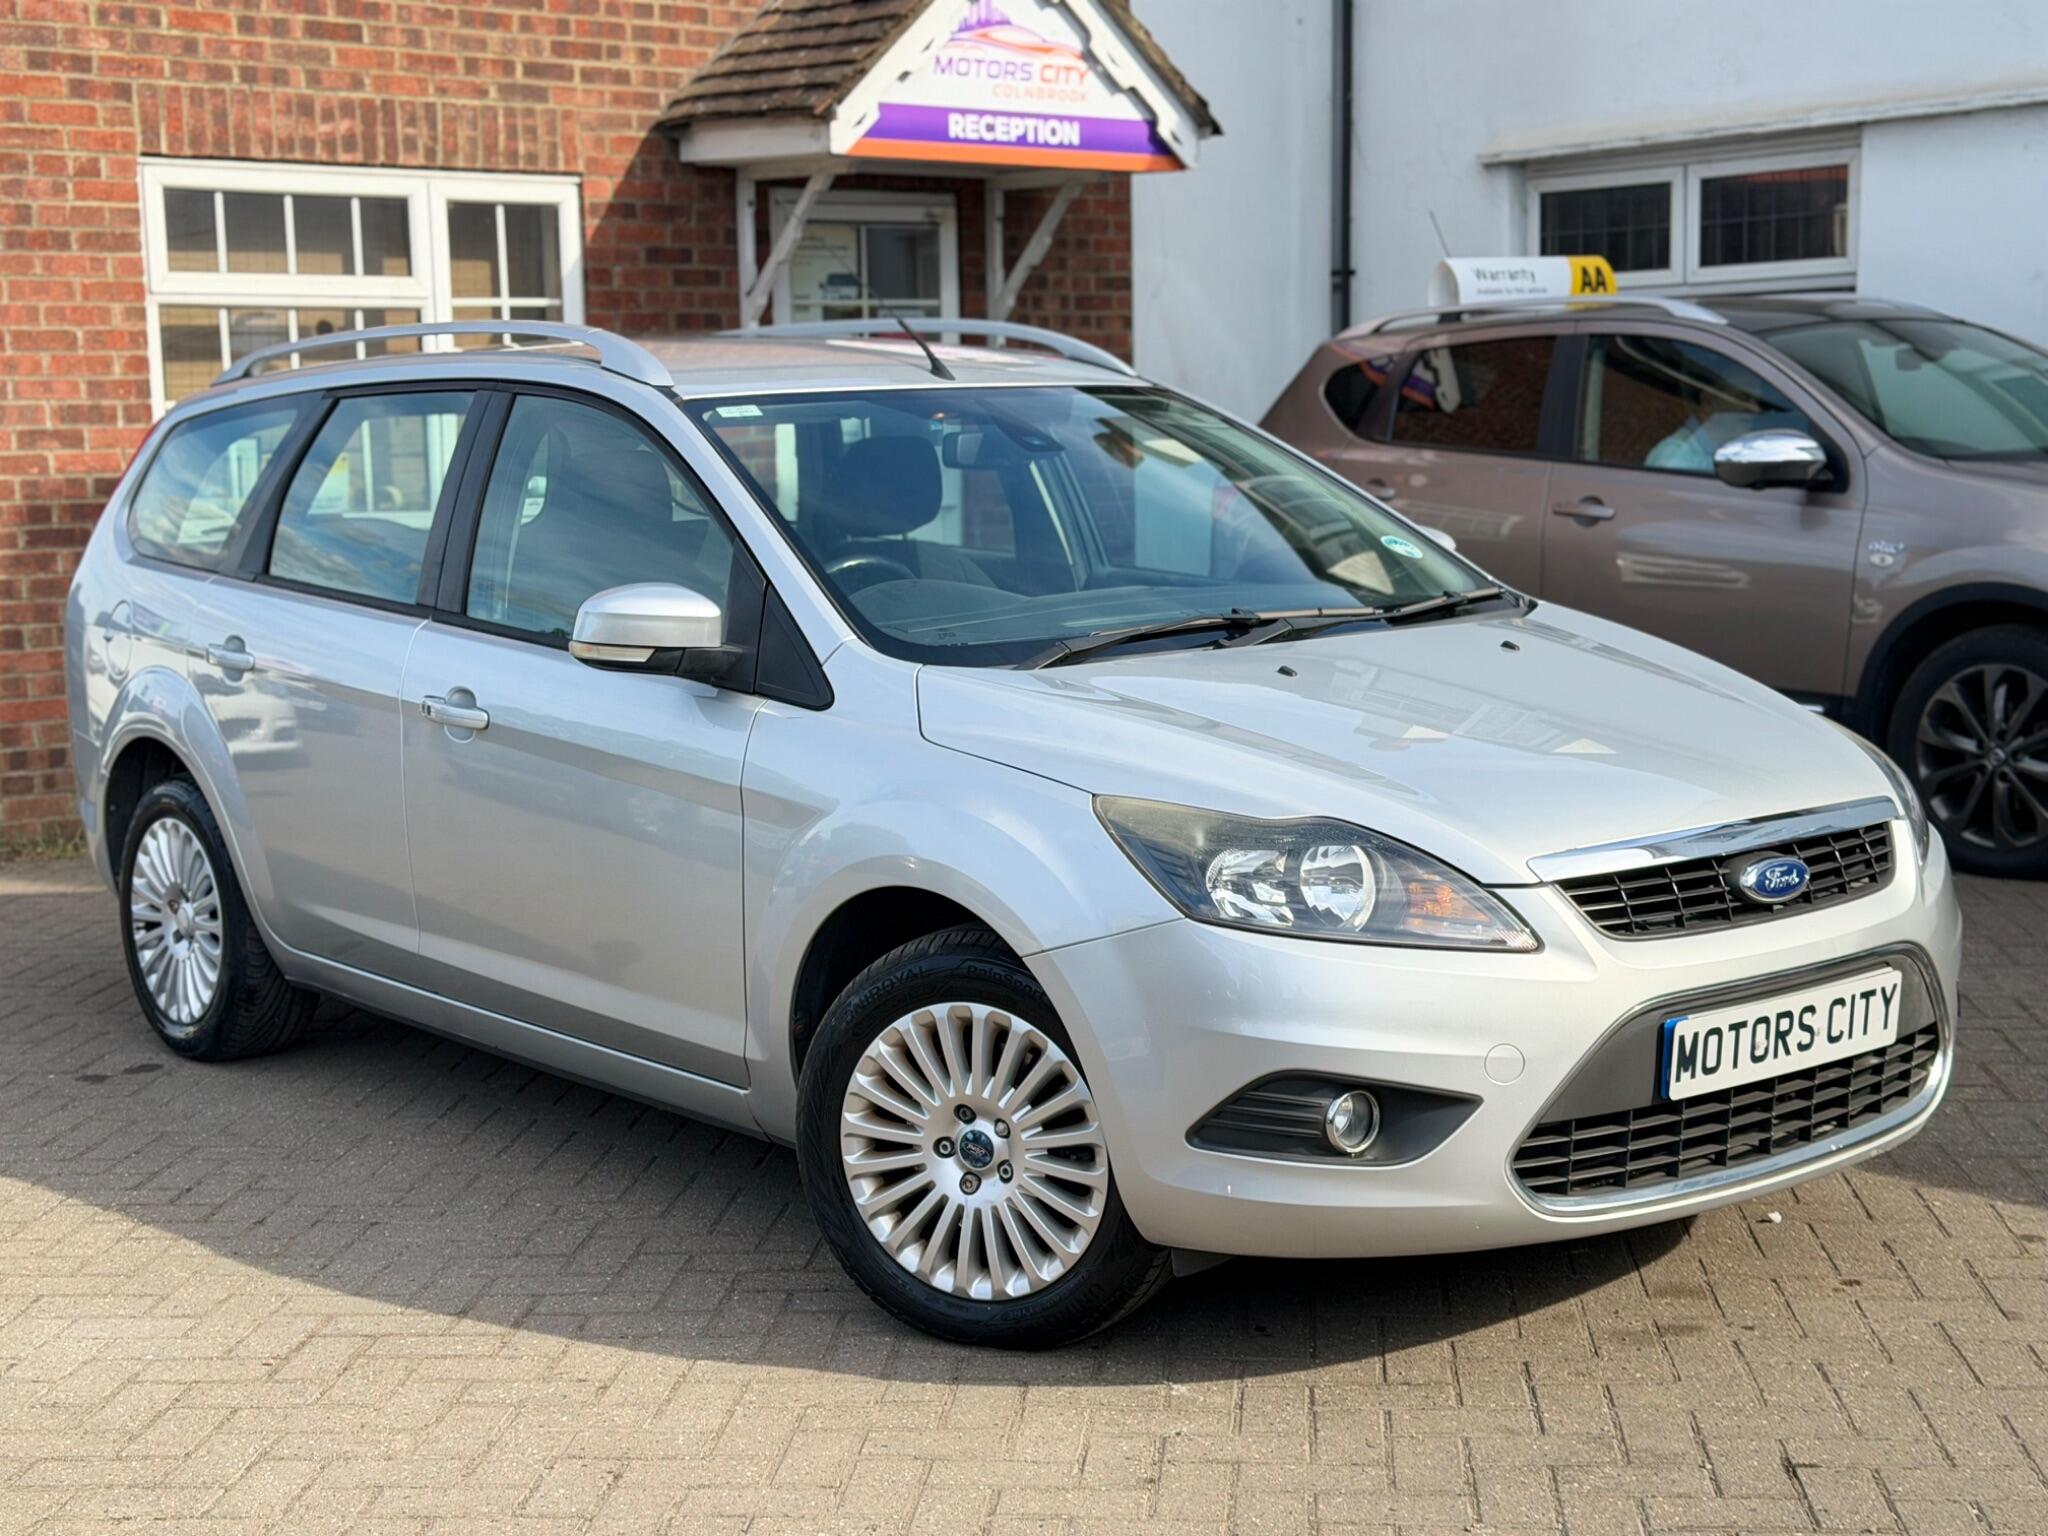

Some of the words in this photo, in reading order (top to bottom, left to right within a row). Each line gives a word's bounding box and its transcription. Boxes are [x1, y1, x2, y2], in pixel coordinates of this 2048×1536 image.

[933, 55, 1033, 82] MOTORS
[1039, 63, 1091, 87] CITY
[948, 113, 1080, 146] RECEPTION
[1472, 267, 1536, 284] Warranty
[1580, 266, 1608, 293] AA
[1765, 865, 1800, 891] Ford
[1675, 1004, 1817, 1083] MOTORS
[1826, 983, 1898, 1045] CITY
